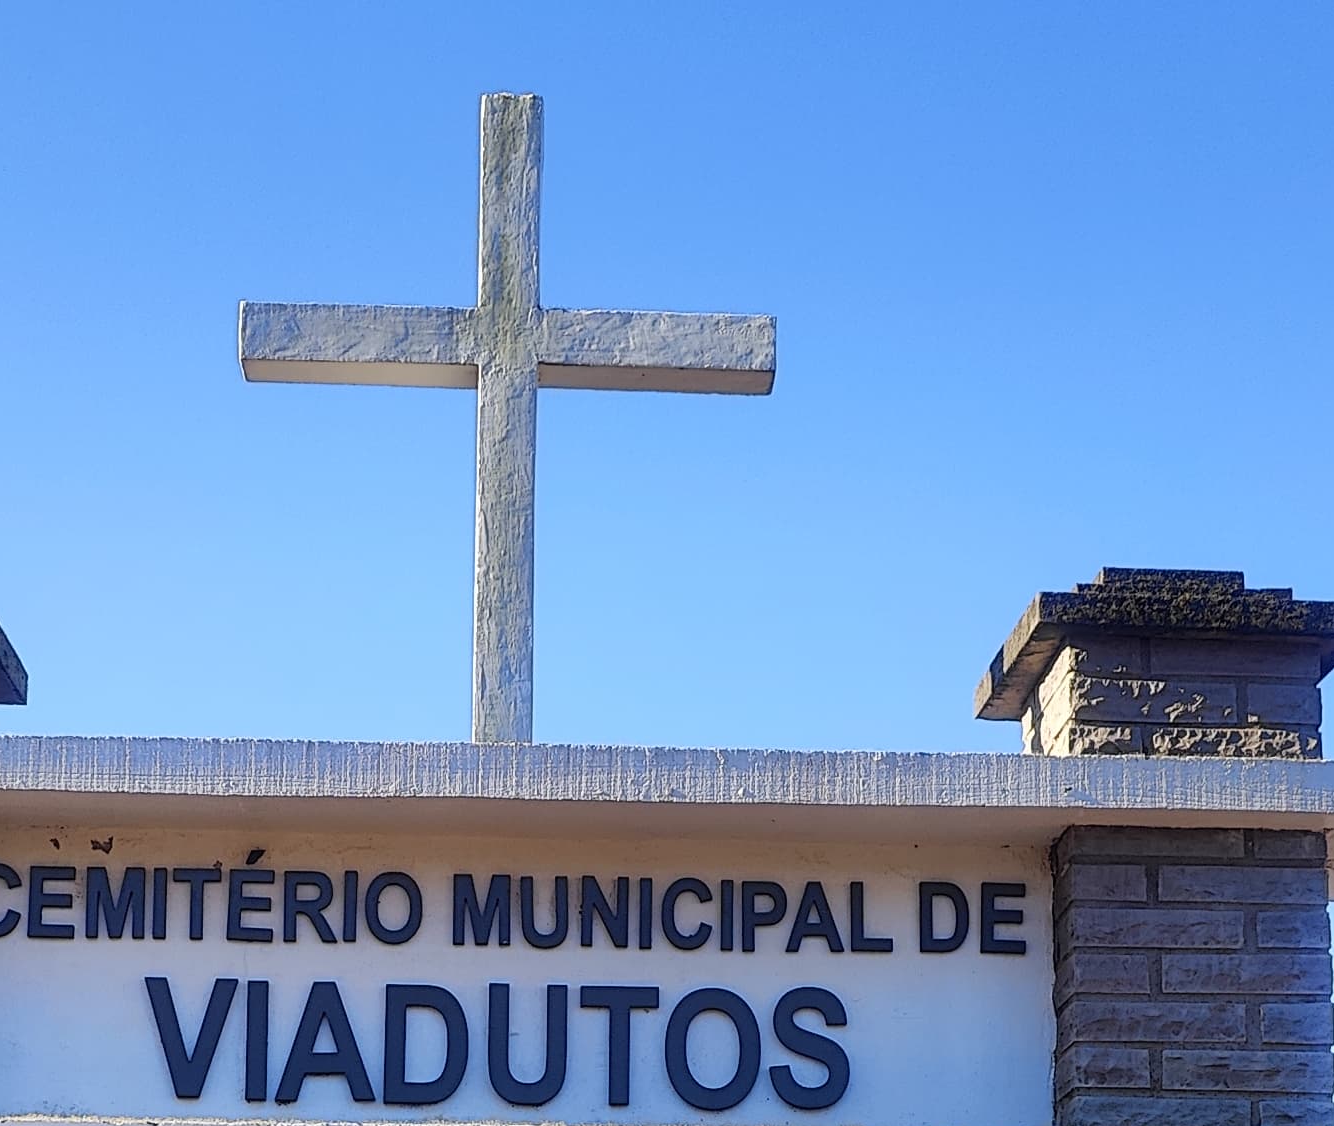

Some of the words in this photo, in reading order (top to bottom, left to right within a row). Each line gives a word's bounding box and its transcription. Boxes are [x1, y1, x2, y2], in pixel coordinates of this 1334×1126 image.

[452, 873, 894, 953] MUNICIPAL
[919, 881, 1027, 955] DE
[145, 976, 851, 1115] VIADUTOS
